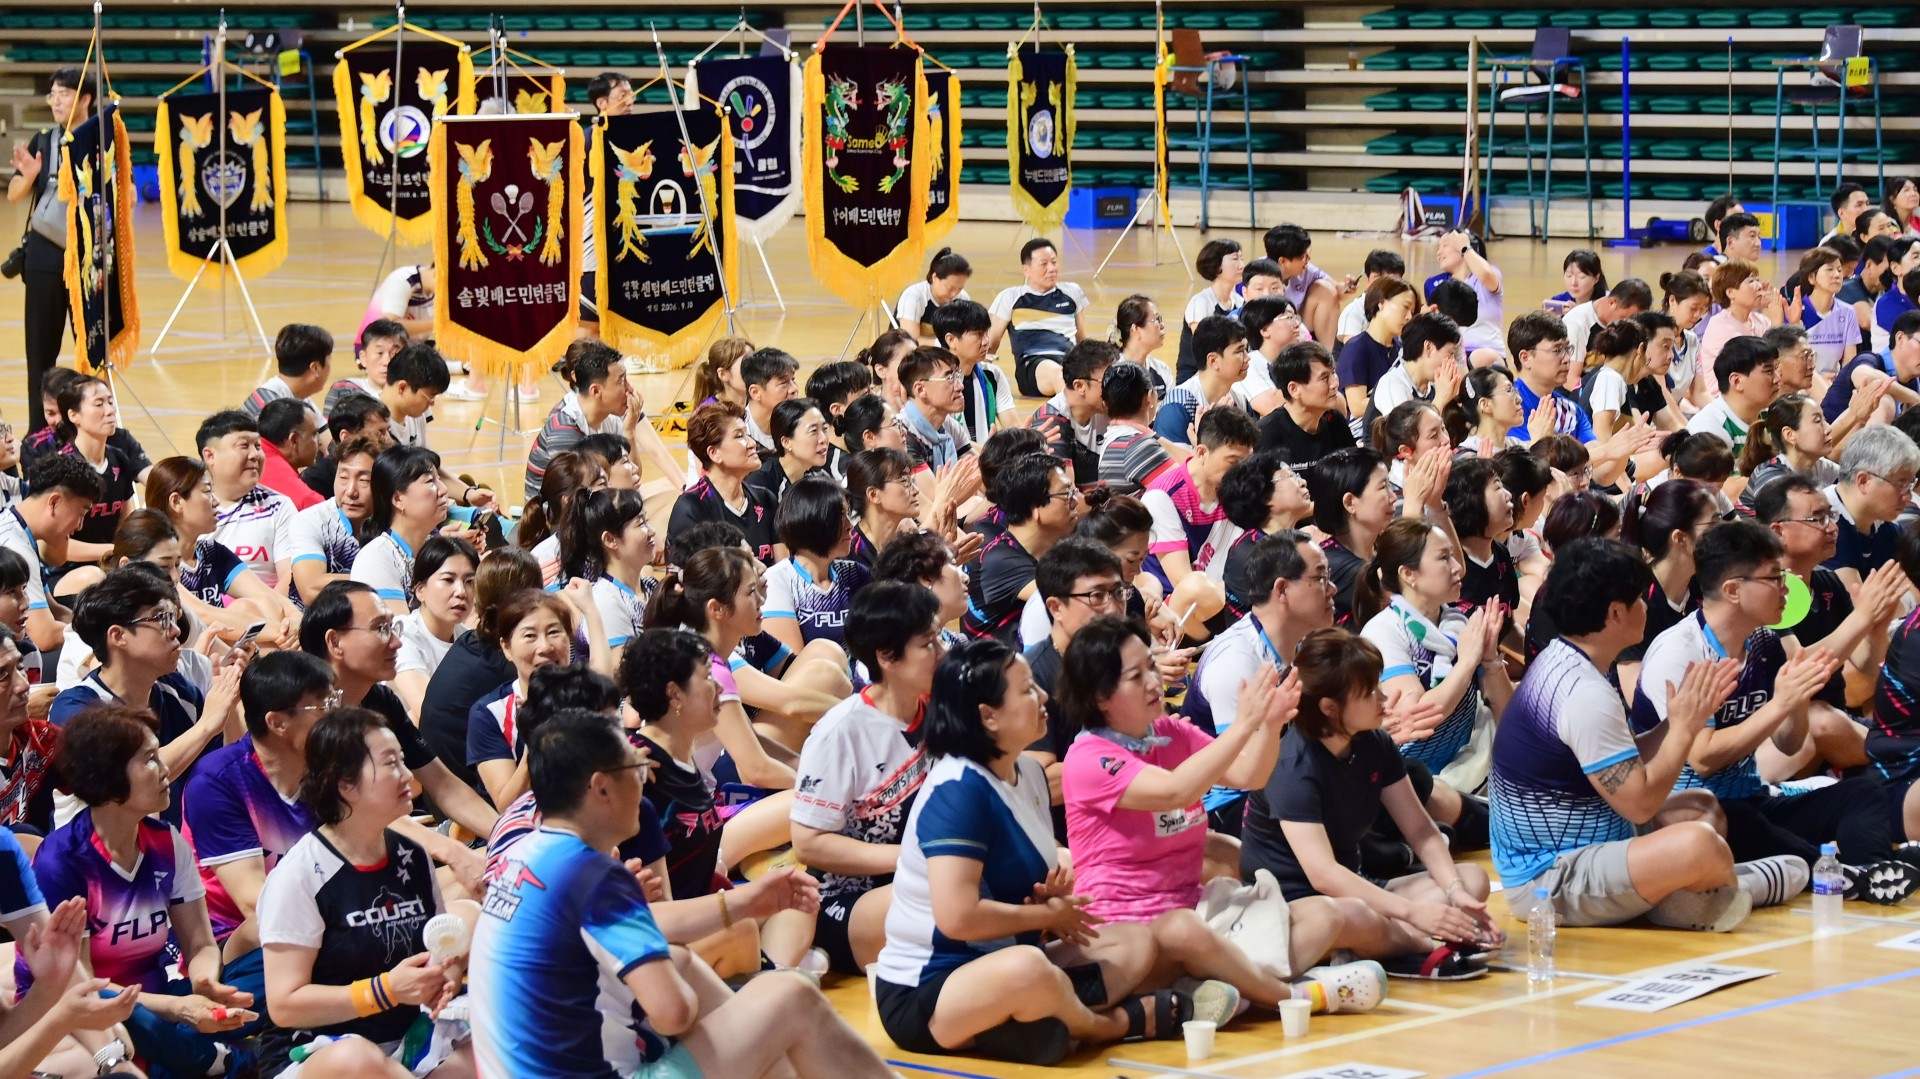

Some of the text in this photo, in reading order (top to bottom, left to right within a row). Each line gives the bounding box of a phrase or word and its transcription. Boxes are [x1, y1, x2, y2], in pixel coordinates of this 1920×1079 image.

[457, 281, 567, 308] 솔빛배드민턴클럽
[1722, 689, 1768, 723] FLP
[346, 894, 425, 927] COURT
[110, 910, 168, 946] FLP
